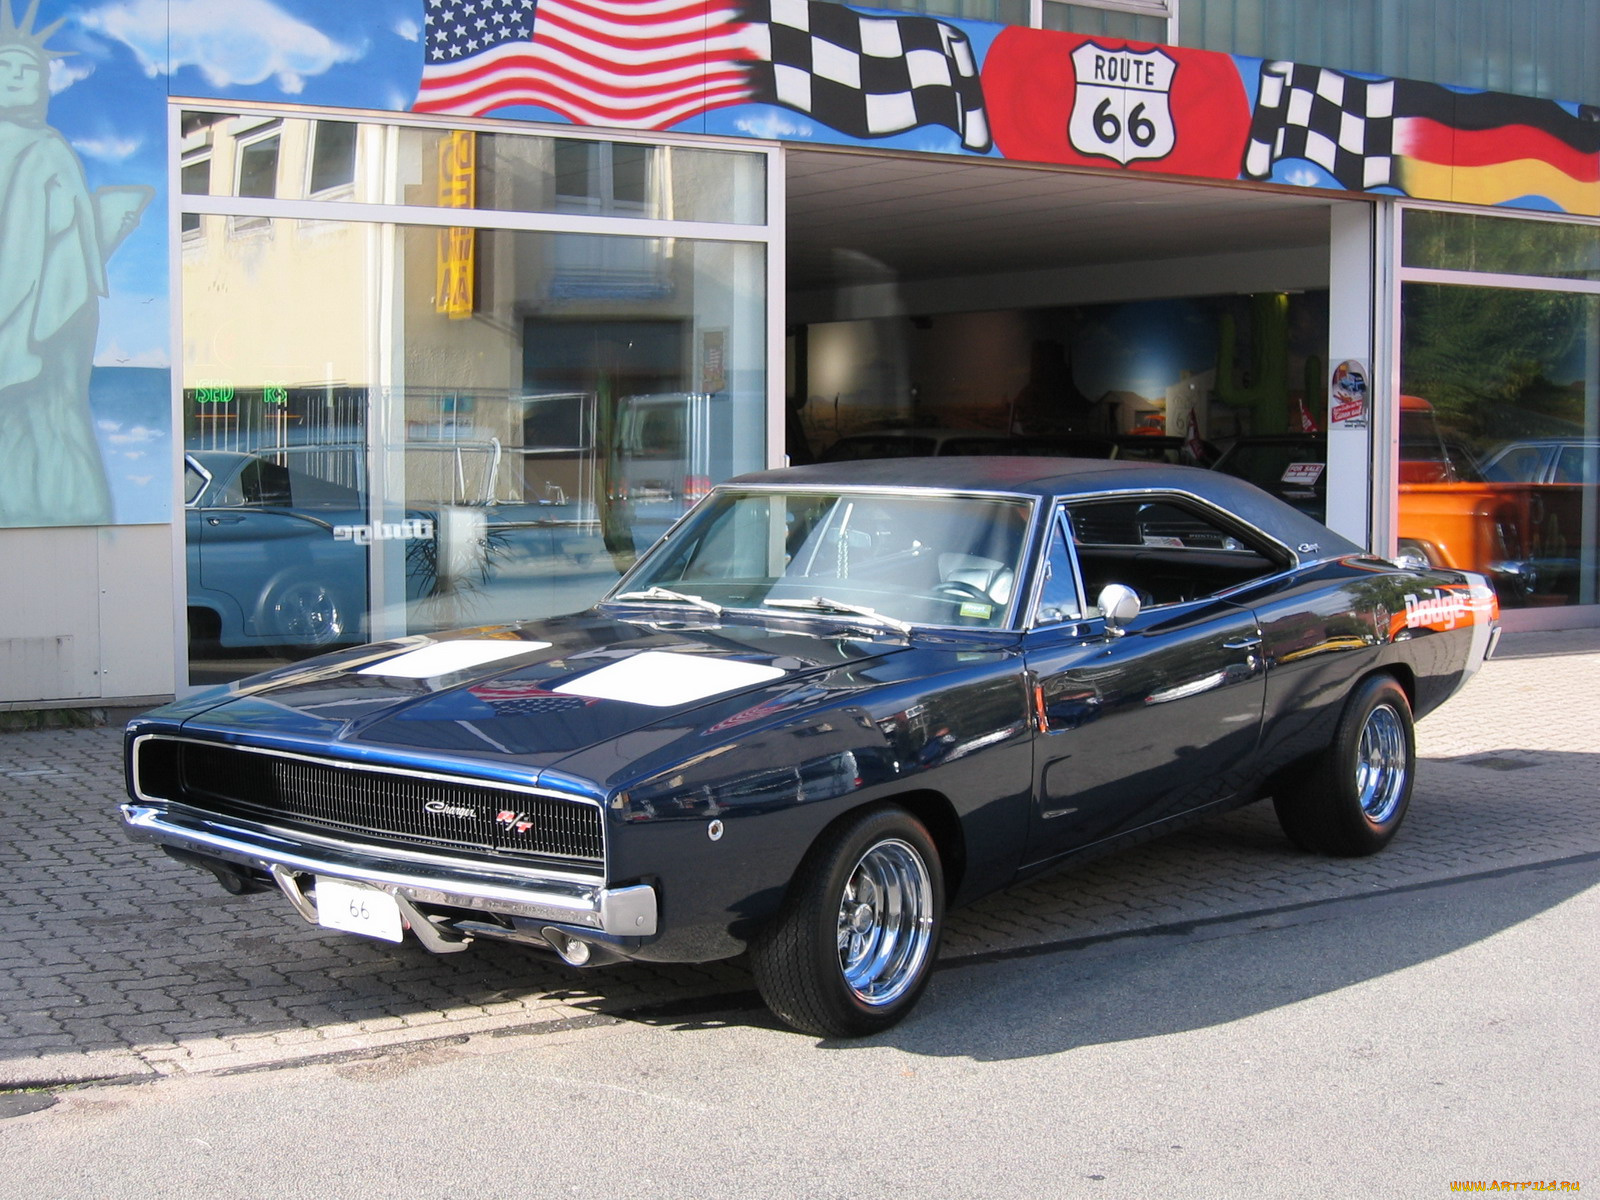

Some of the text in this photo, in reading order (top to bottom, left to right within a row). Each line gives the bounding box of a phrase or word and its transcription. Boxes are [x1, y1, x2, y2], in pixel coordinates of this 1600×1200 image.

[1094, 54, 1155, 86] ROUTE
[1093, 97, 1156, 148] 66
[263, 379, 288, 403] RS
[1289, 464, 1322, 473] FOR SALE
[1404, 588, 1466, 630] Dodge
[425, 801, 534, 833] Charger R/T
[349, 899, 370, 920] 66
